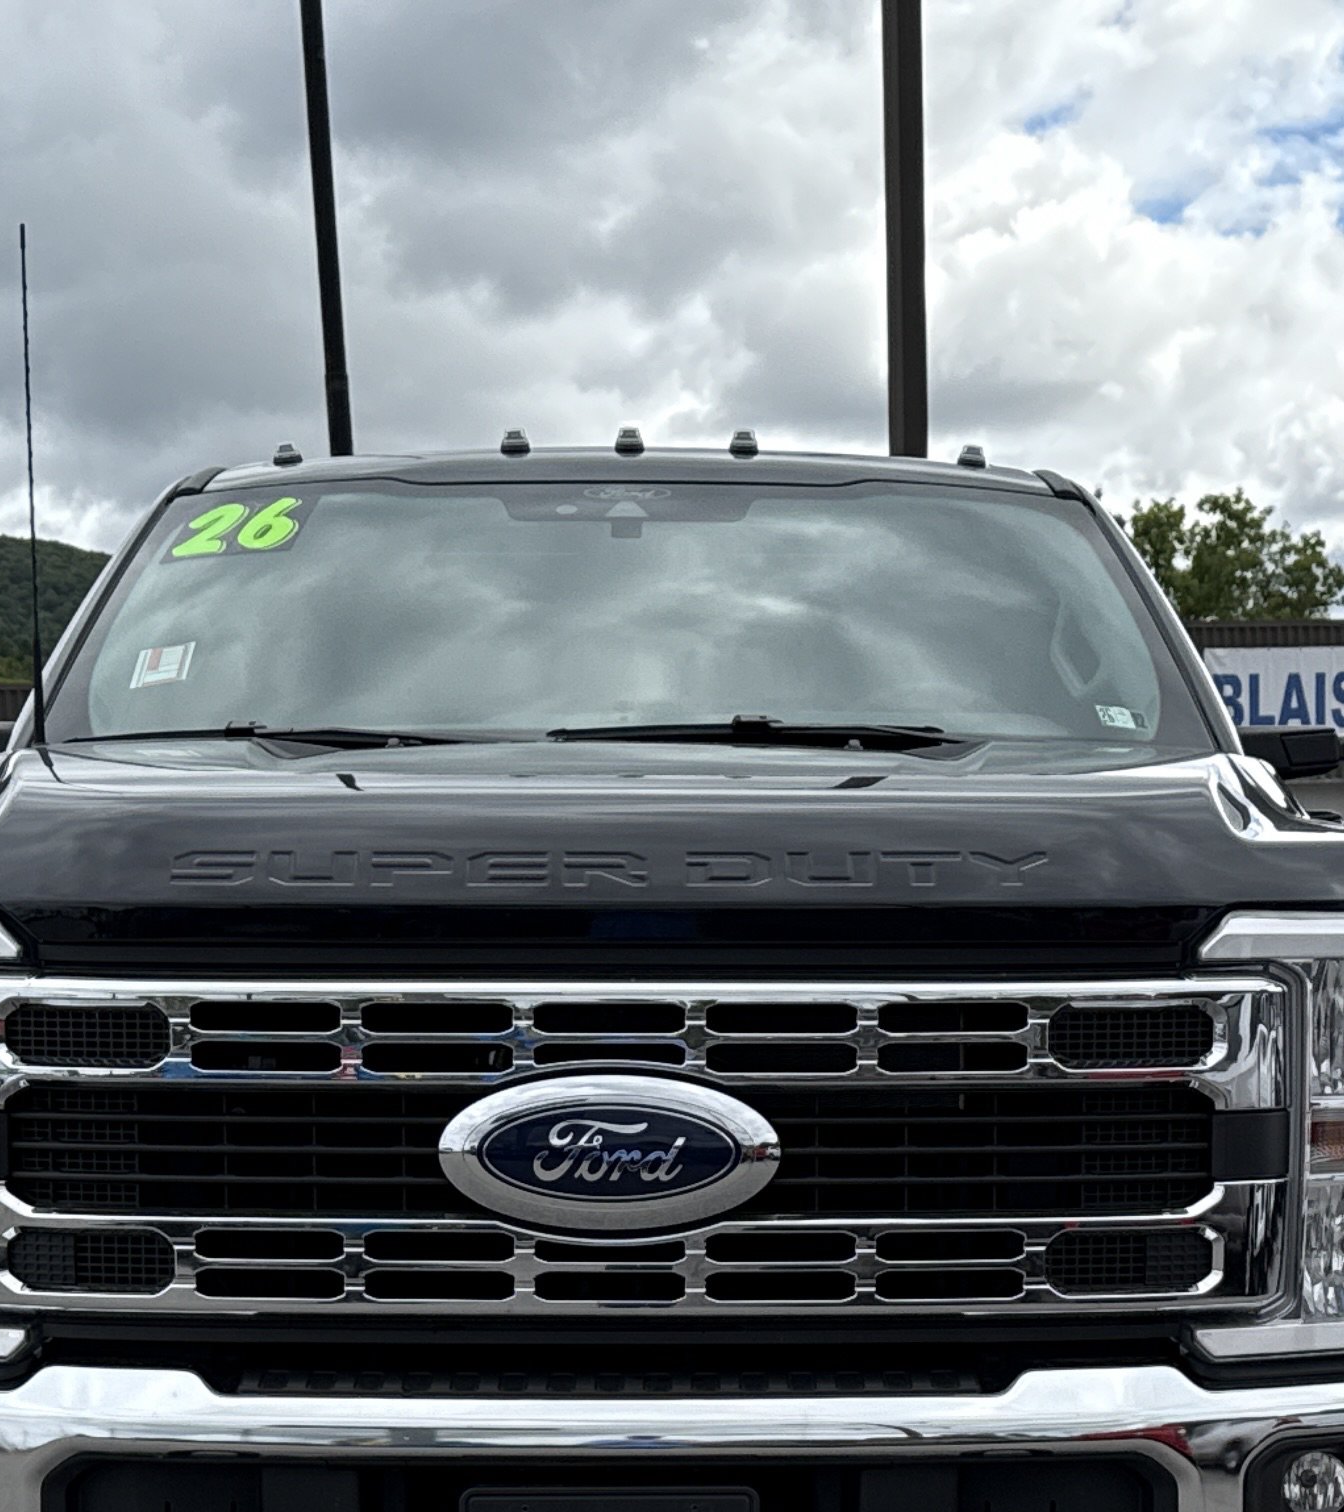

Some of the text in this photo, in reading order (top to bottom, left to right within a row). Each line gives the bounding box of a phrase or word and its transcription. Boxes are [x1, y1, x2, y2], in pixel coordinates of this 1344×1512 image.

[172, 497, 302, 557] 26
[168, 849, 1051, 888] SUPER DUTY
[532, 1119, 688, 1182] Ford
